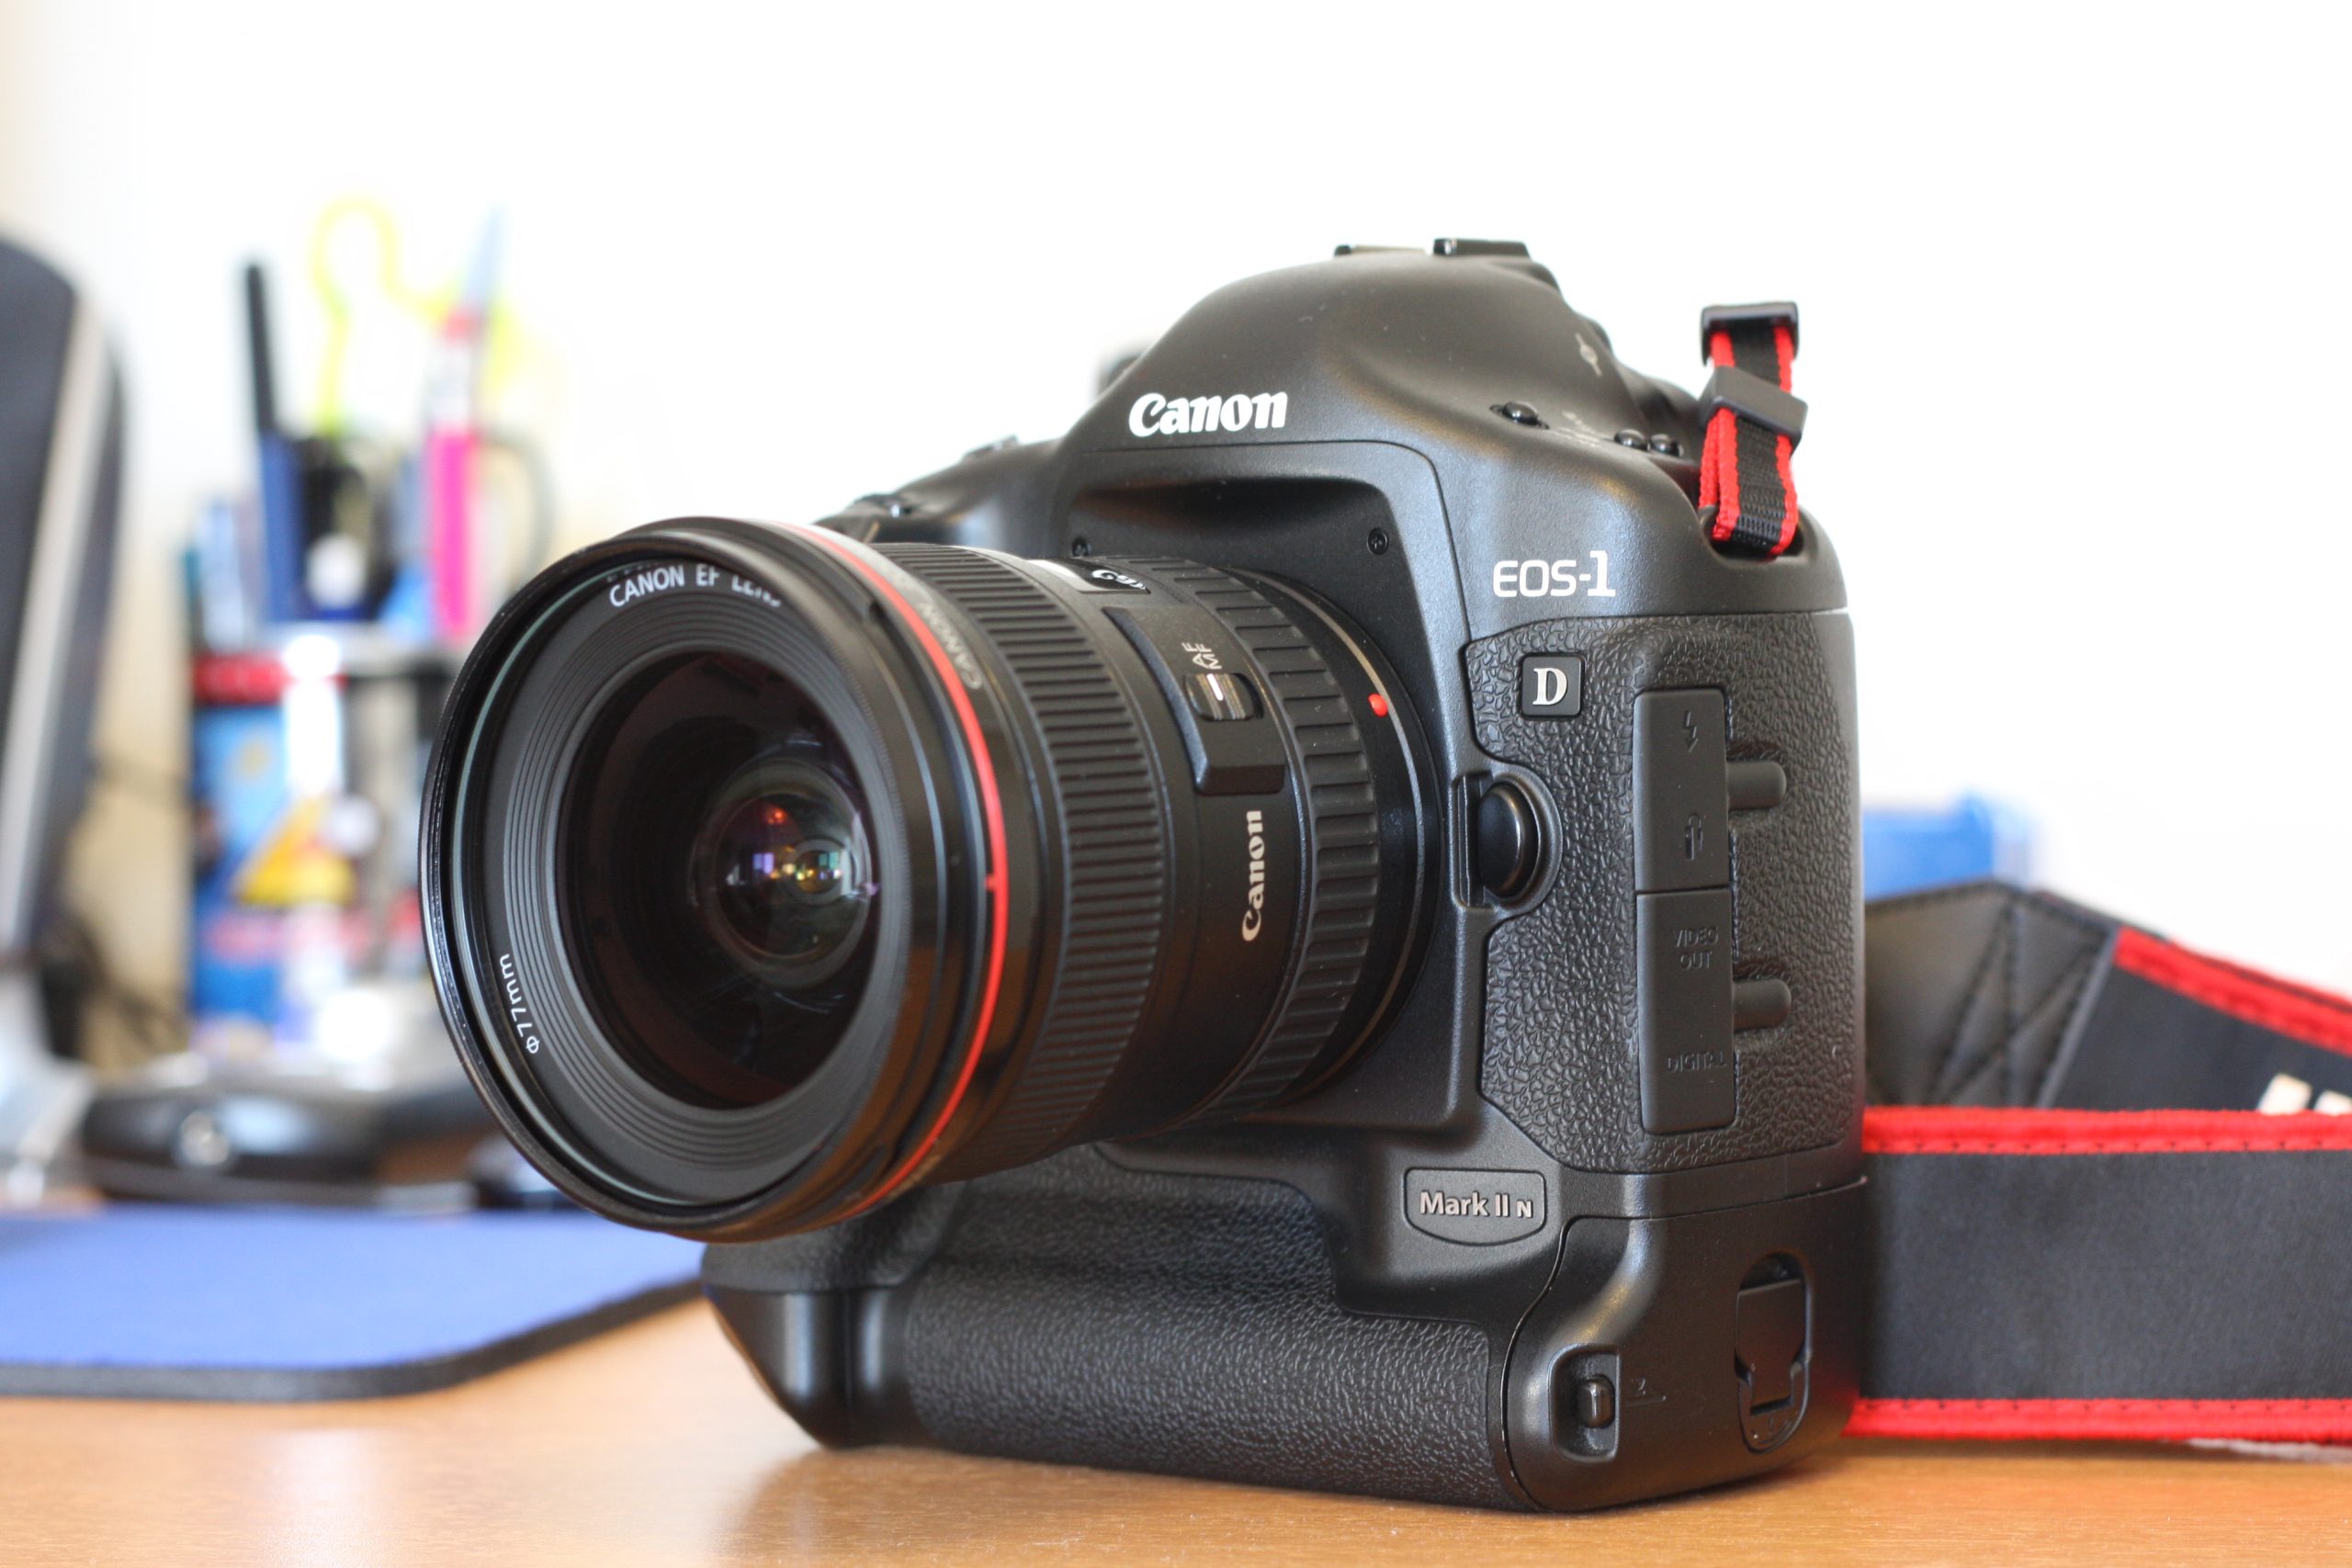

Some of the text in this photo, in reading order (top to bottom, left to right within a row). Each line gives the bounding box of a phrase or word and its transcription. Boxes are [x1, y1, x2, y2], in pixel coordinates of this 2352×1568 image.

[1128, 391, 1288, 437] Canon
[609, 565, 685, 607] CANON
[695, 563, 720, 587] EF
[1492, 550, 1616, 597] EOS-1
[1182, 642, 1209, 670] AF
[1194, 642, 1223, 671] MF
[1532, 667, 1567, 706] D
[1241, 810, 1265, 942] Canon
[1673, 927, 1719, 948] VIDEO
[1679, 950, 1713, 970] OUT
[1419, 1191, 1533, 1218] Mark II N
